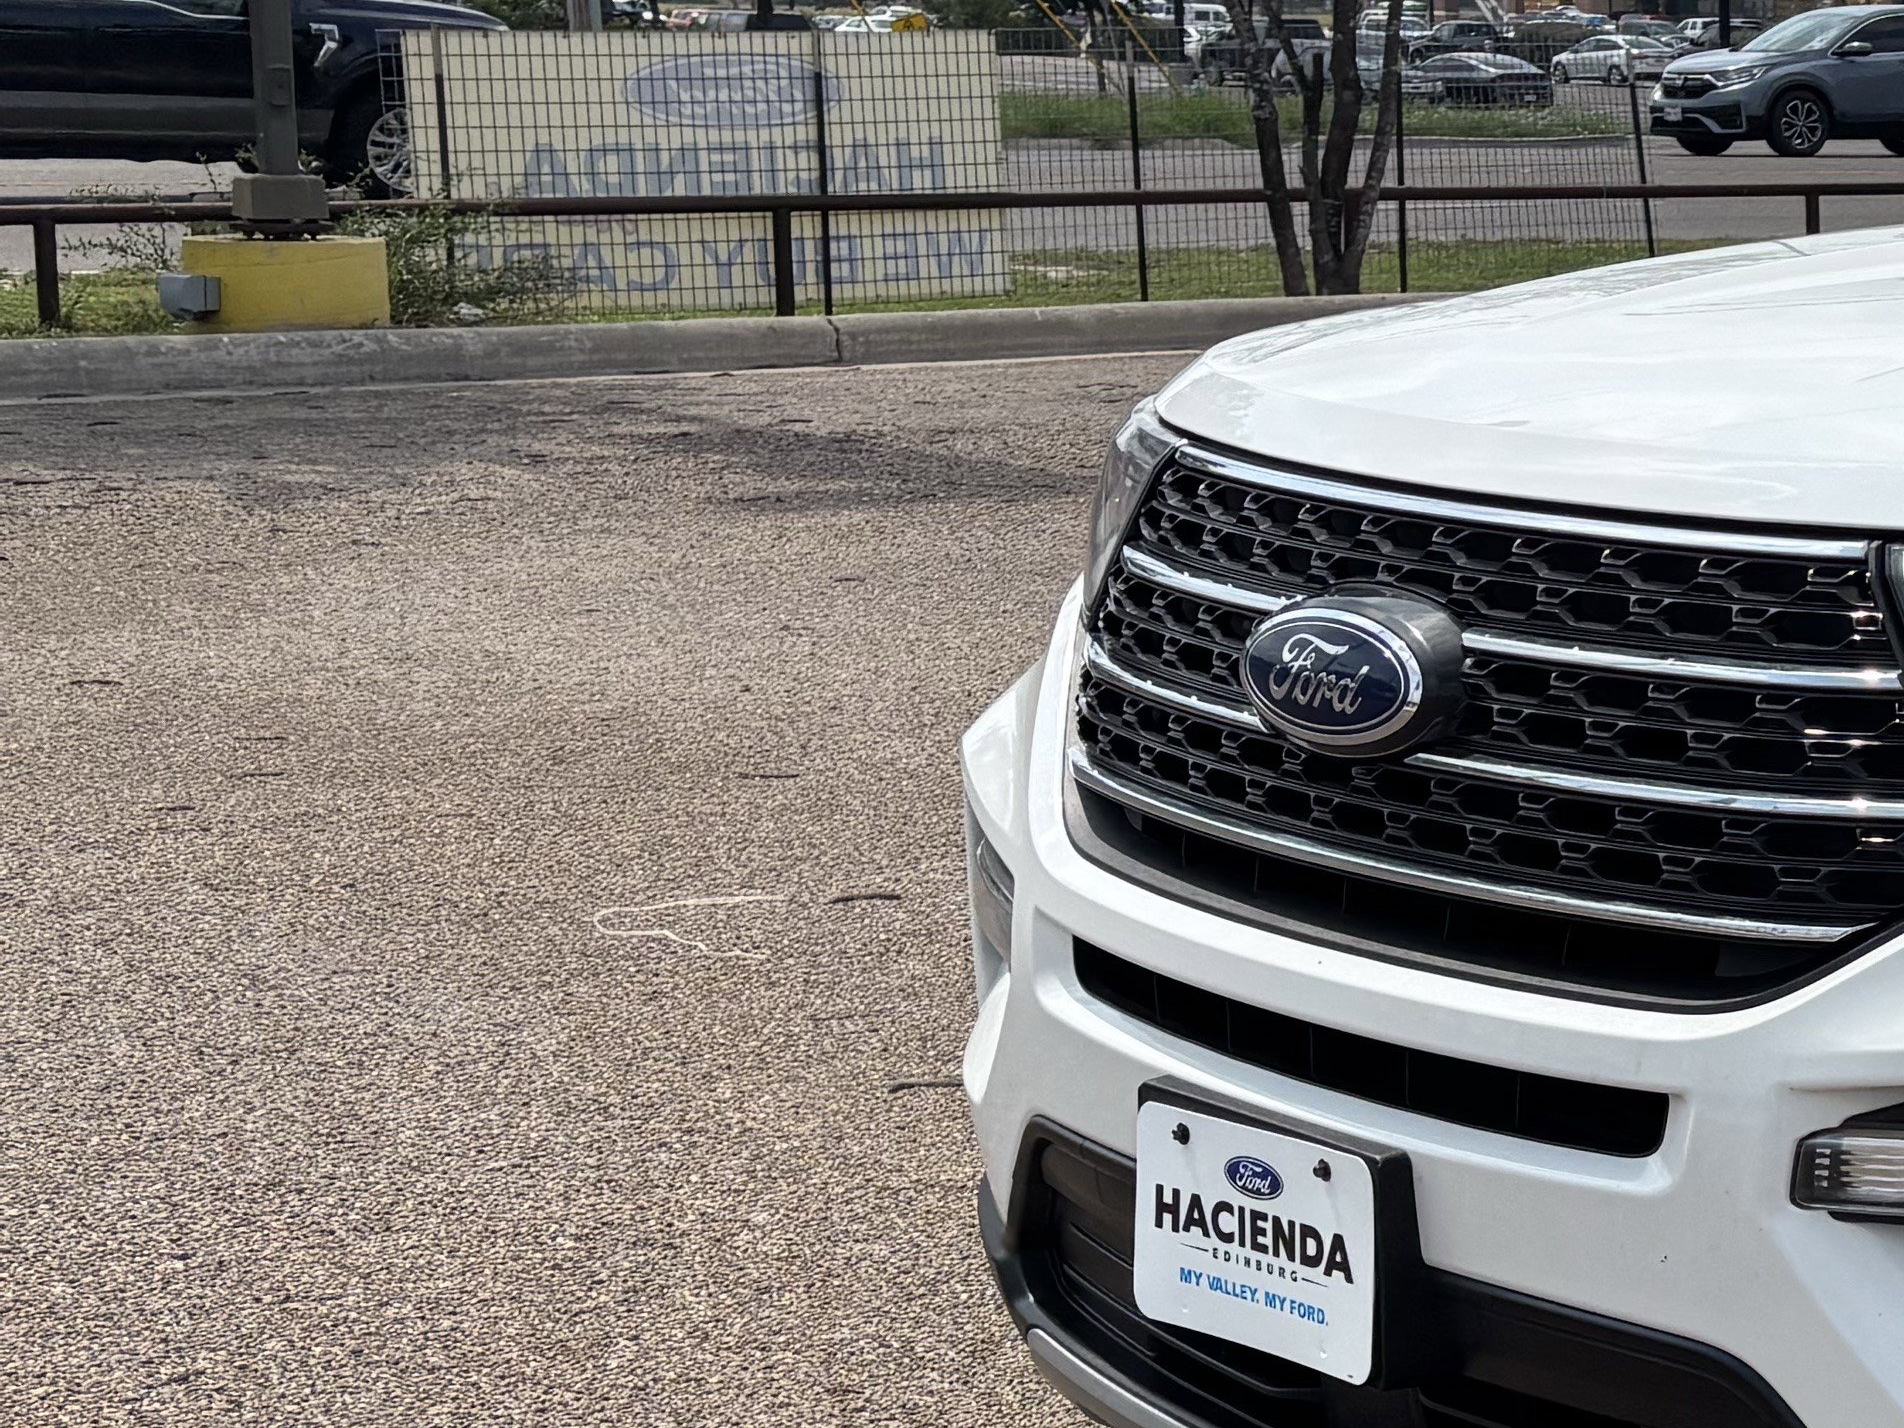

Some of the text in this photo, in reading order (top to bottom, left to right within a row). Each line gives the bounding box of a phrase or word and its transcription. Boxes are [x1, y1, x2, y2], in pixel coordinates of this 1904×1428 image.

[1268, 632, 1371, 715] Ford
[1235, 1159, 1272, 1195] Ford
[1154, 1184, 1354, 1285] HACIENDA
[1212, 1248, 1299, 1283] EDINBURG
[1179, 1267, 1203, 1287] MY
[1264, 1291, 1287, 1312] MY
